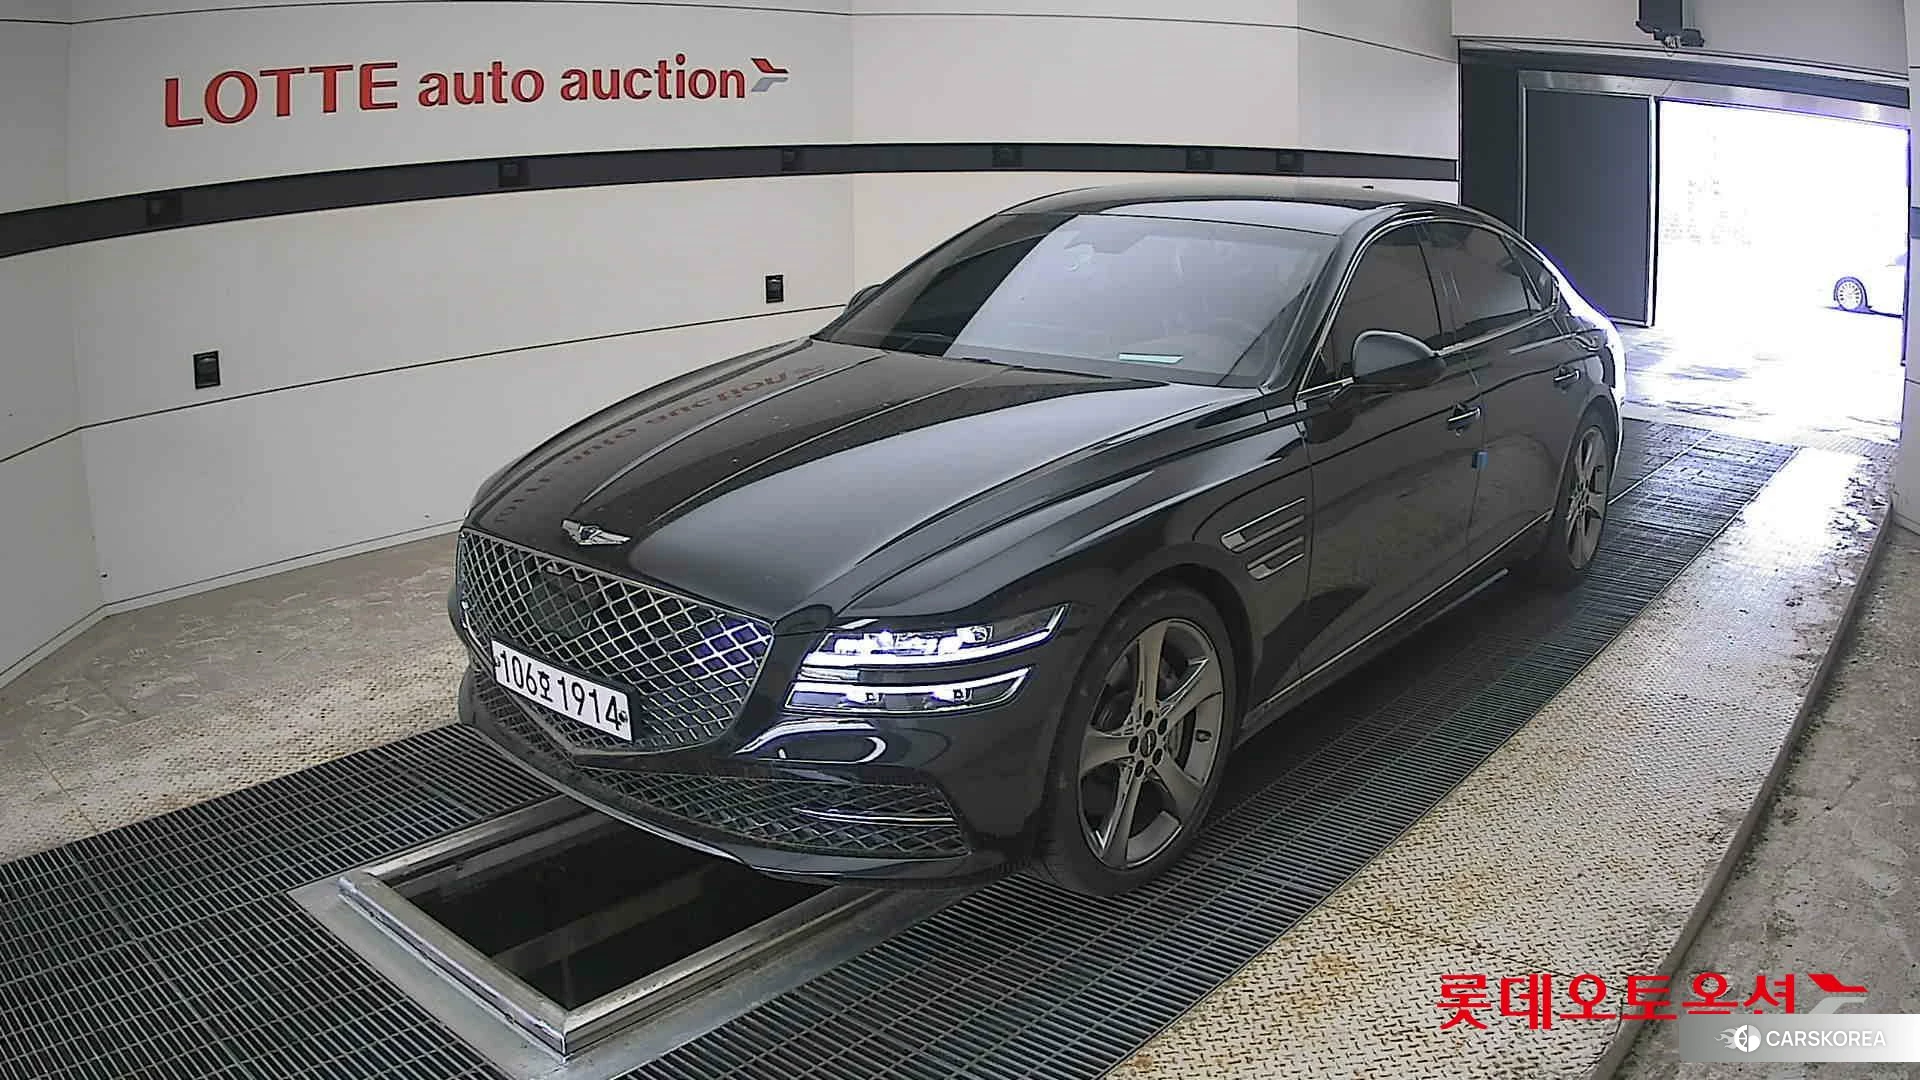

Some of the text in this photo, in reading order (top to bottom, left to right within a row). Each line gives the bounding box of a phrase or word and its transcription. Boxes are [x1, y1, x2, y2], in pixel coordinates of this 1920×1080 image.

[165, 54, 746, 127] LOTTE auto auction
[557, 676, 622, 731] 1914
